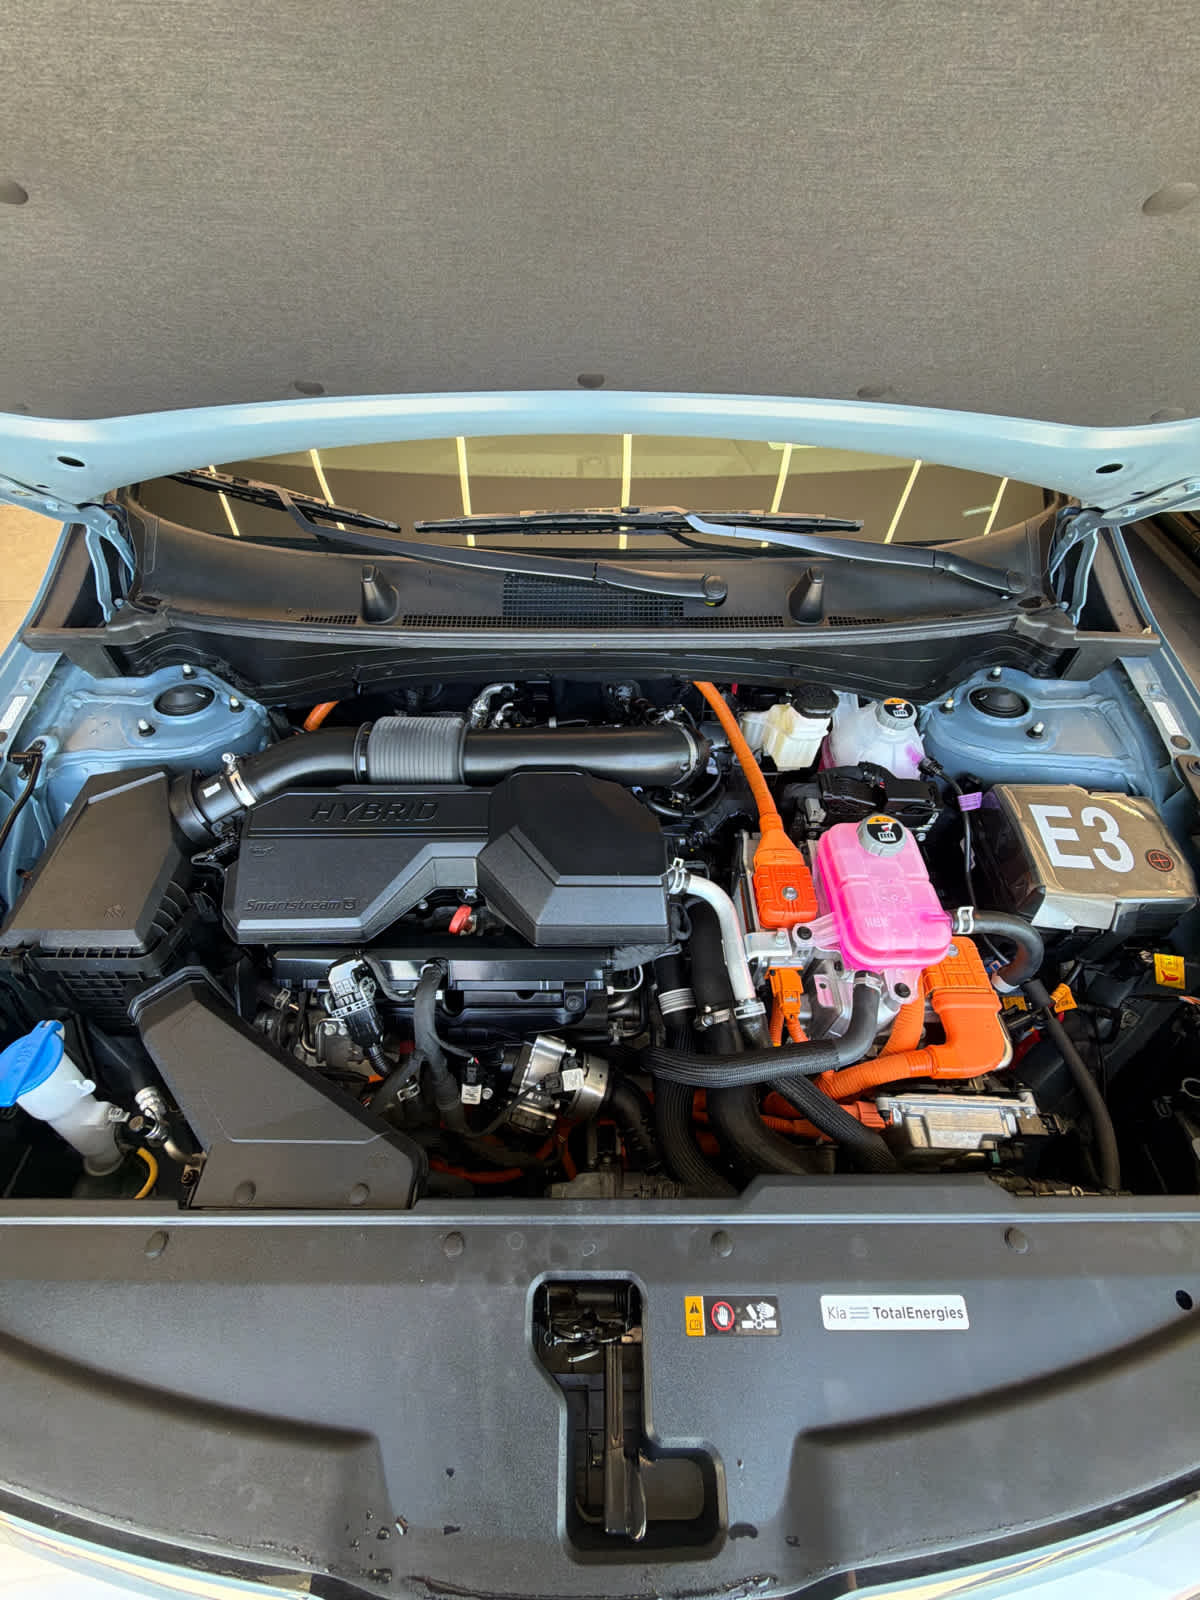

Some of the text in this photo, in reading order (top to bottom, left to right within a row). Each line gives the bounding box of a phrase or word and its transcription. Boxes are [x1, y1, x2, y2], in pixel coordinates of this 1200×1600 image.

[311, 801, 438, 822] HYBRID
[1028, 804, 1135, 873] E3
[244, 899, 341, 912] Smartstream
[826, 1306, 964, 1321] Kia TotalEnergies
